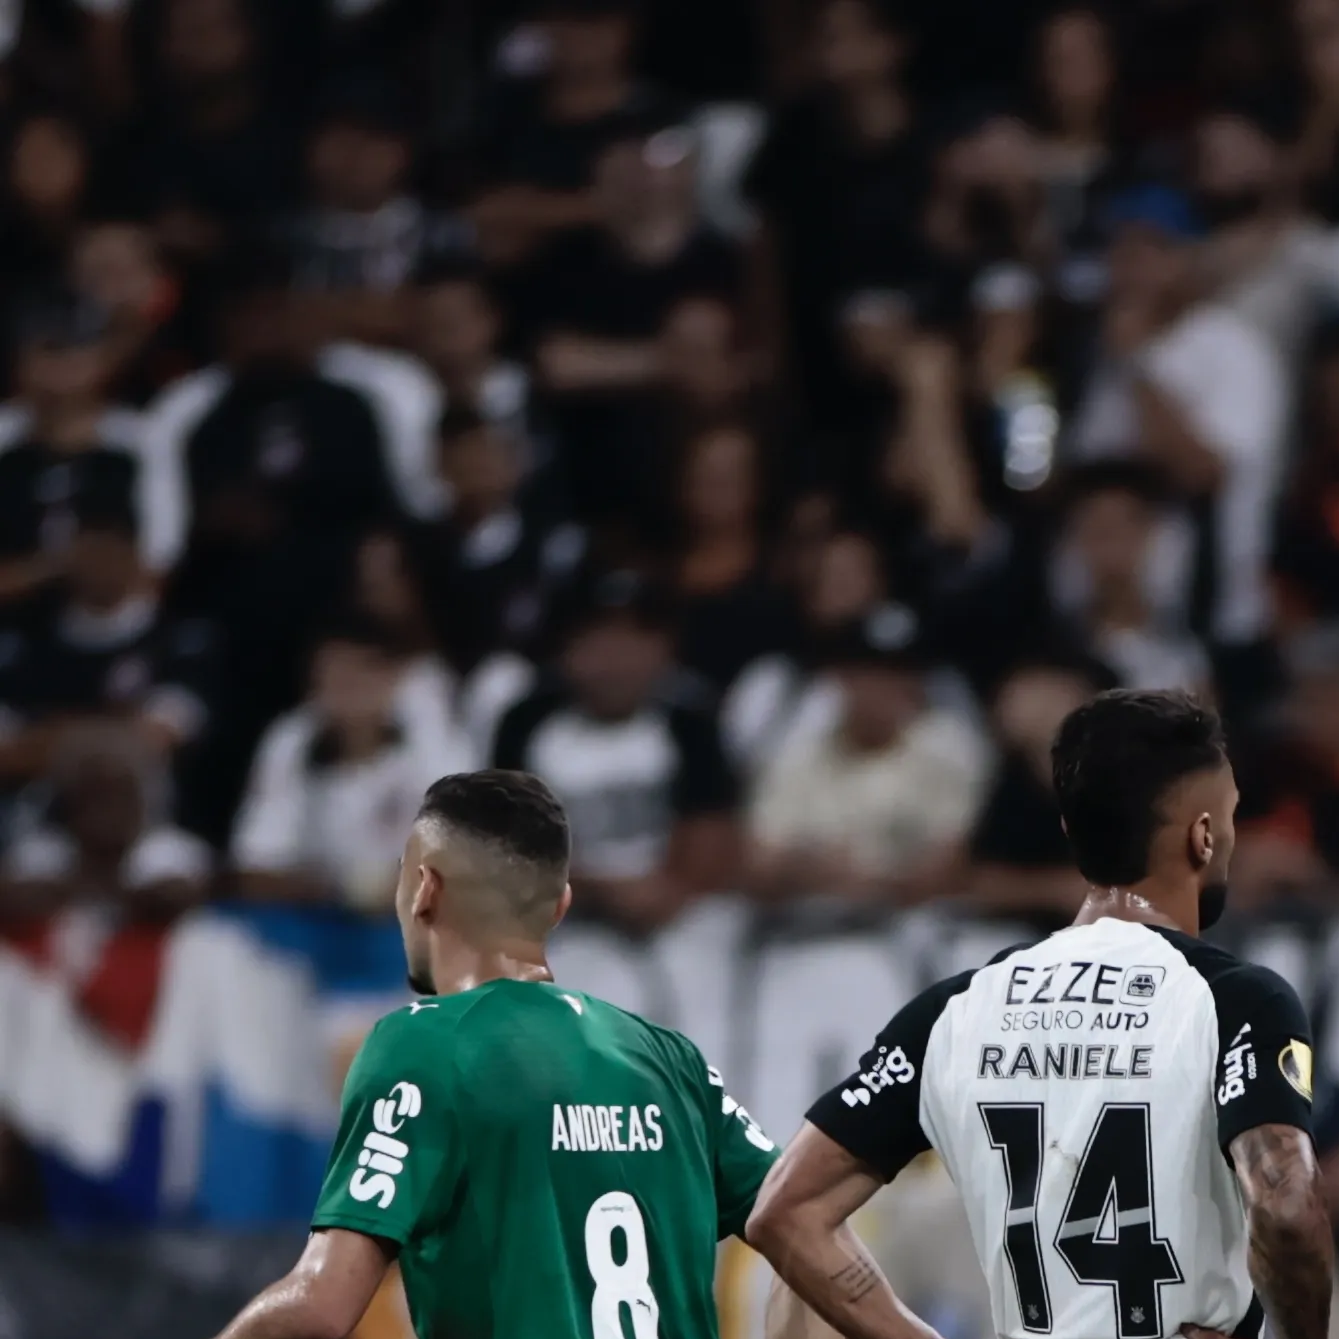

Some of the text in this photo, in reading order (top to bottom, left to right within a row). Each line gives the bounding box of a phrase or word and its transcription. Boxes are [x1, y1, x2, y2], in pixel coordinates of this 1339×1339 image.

[1006, 962, 1123, 1005] EZZE
[1001, 1010, 1149, 1031] SEGURO AUTO
[977, 1043, 1156, 1080] RANIELE
[551, 1103, 664, 1152] ANDREAS
